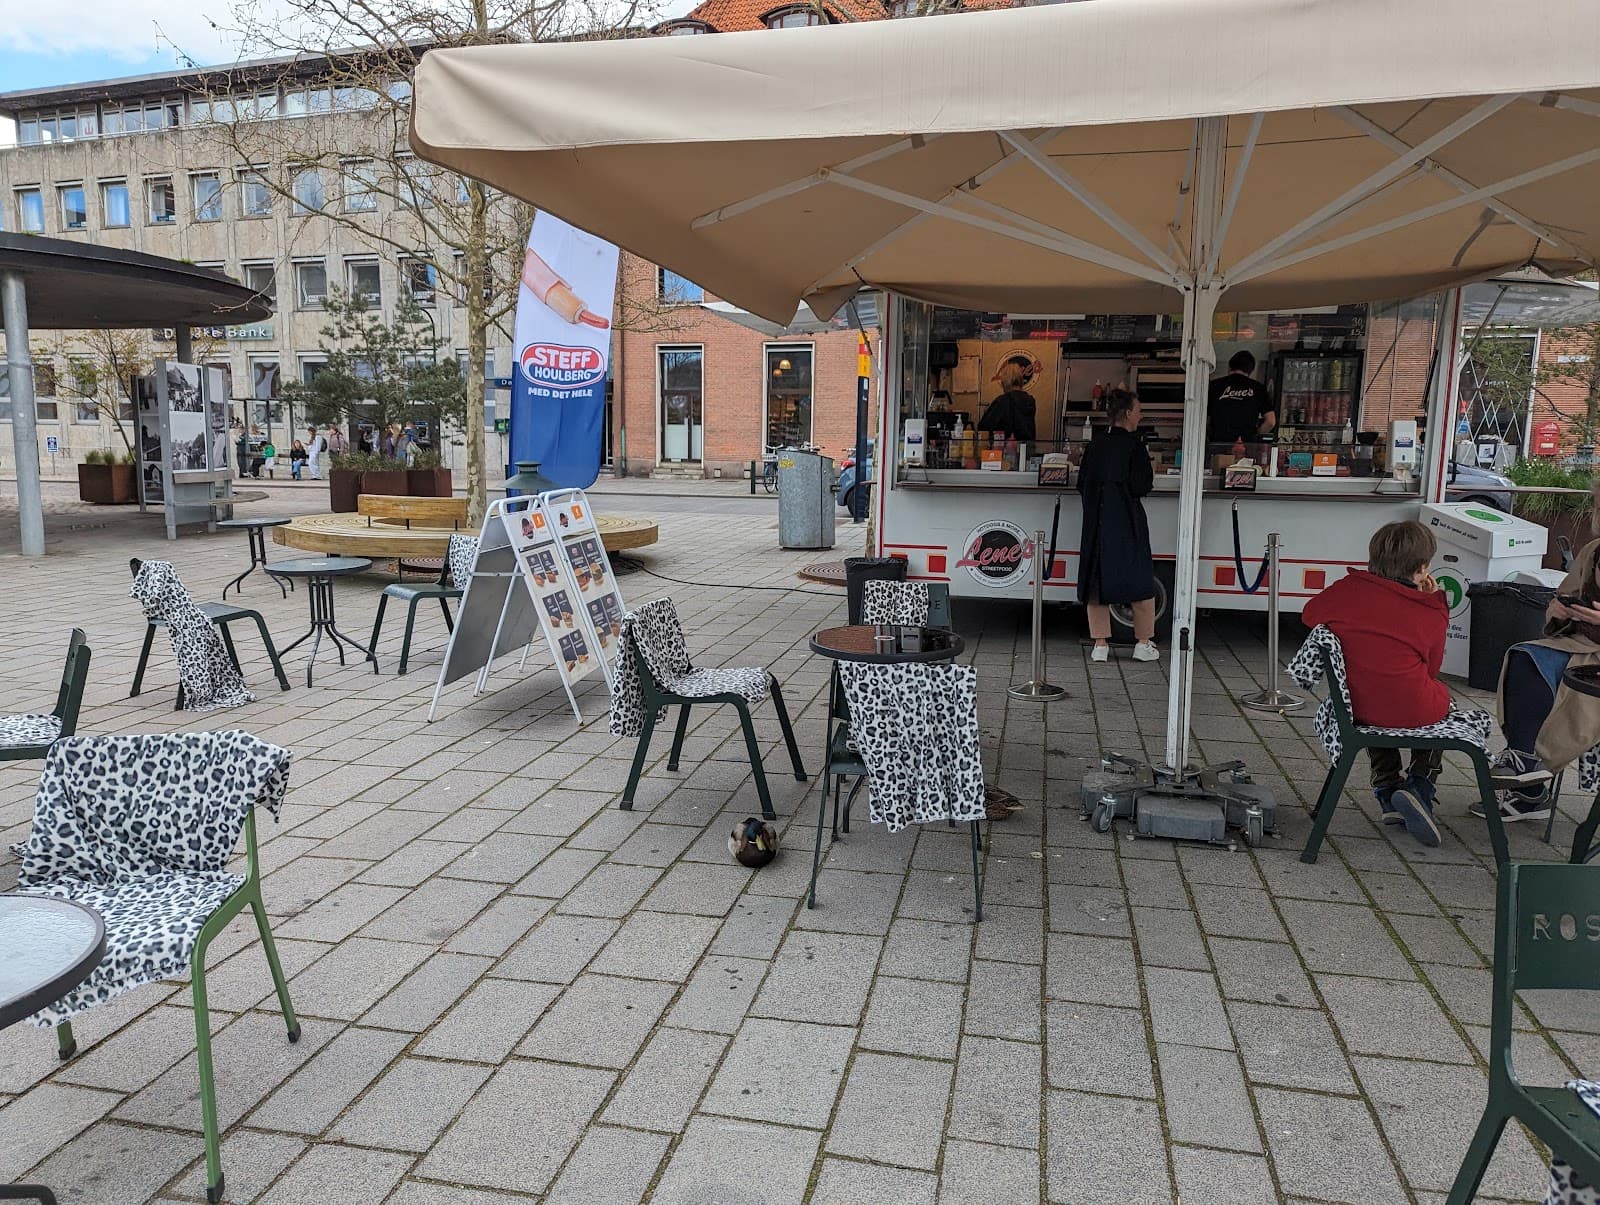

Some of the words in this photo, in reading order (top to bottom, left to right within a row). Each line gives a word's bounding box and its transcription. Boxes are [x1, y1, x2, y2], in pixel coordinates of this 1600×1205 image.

[164, 328, 220, 340] Dske
[227, 327, 267, 338] Bank
[534, 347, 592, 369] STEFF
[534, 366, 591, 381] HOULBERG
[528, 387, 550, 397] MED
[552, 390, 571, 399] DET
[571, 389, 593, 398] HELE
[1532, 913, 1600, 941] ROS
